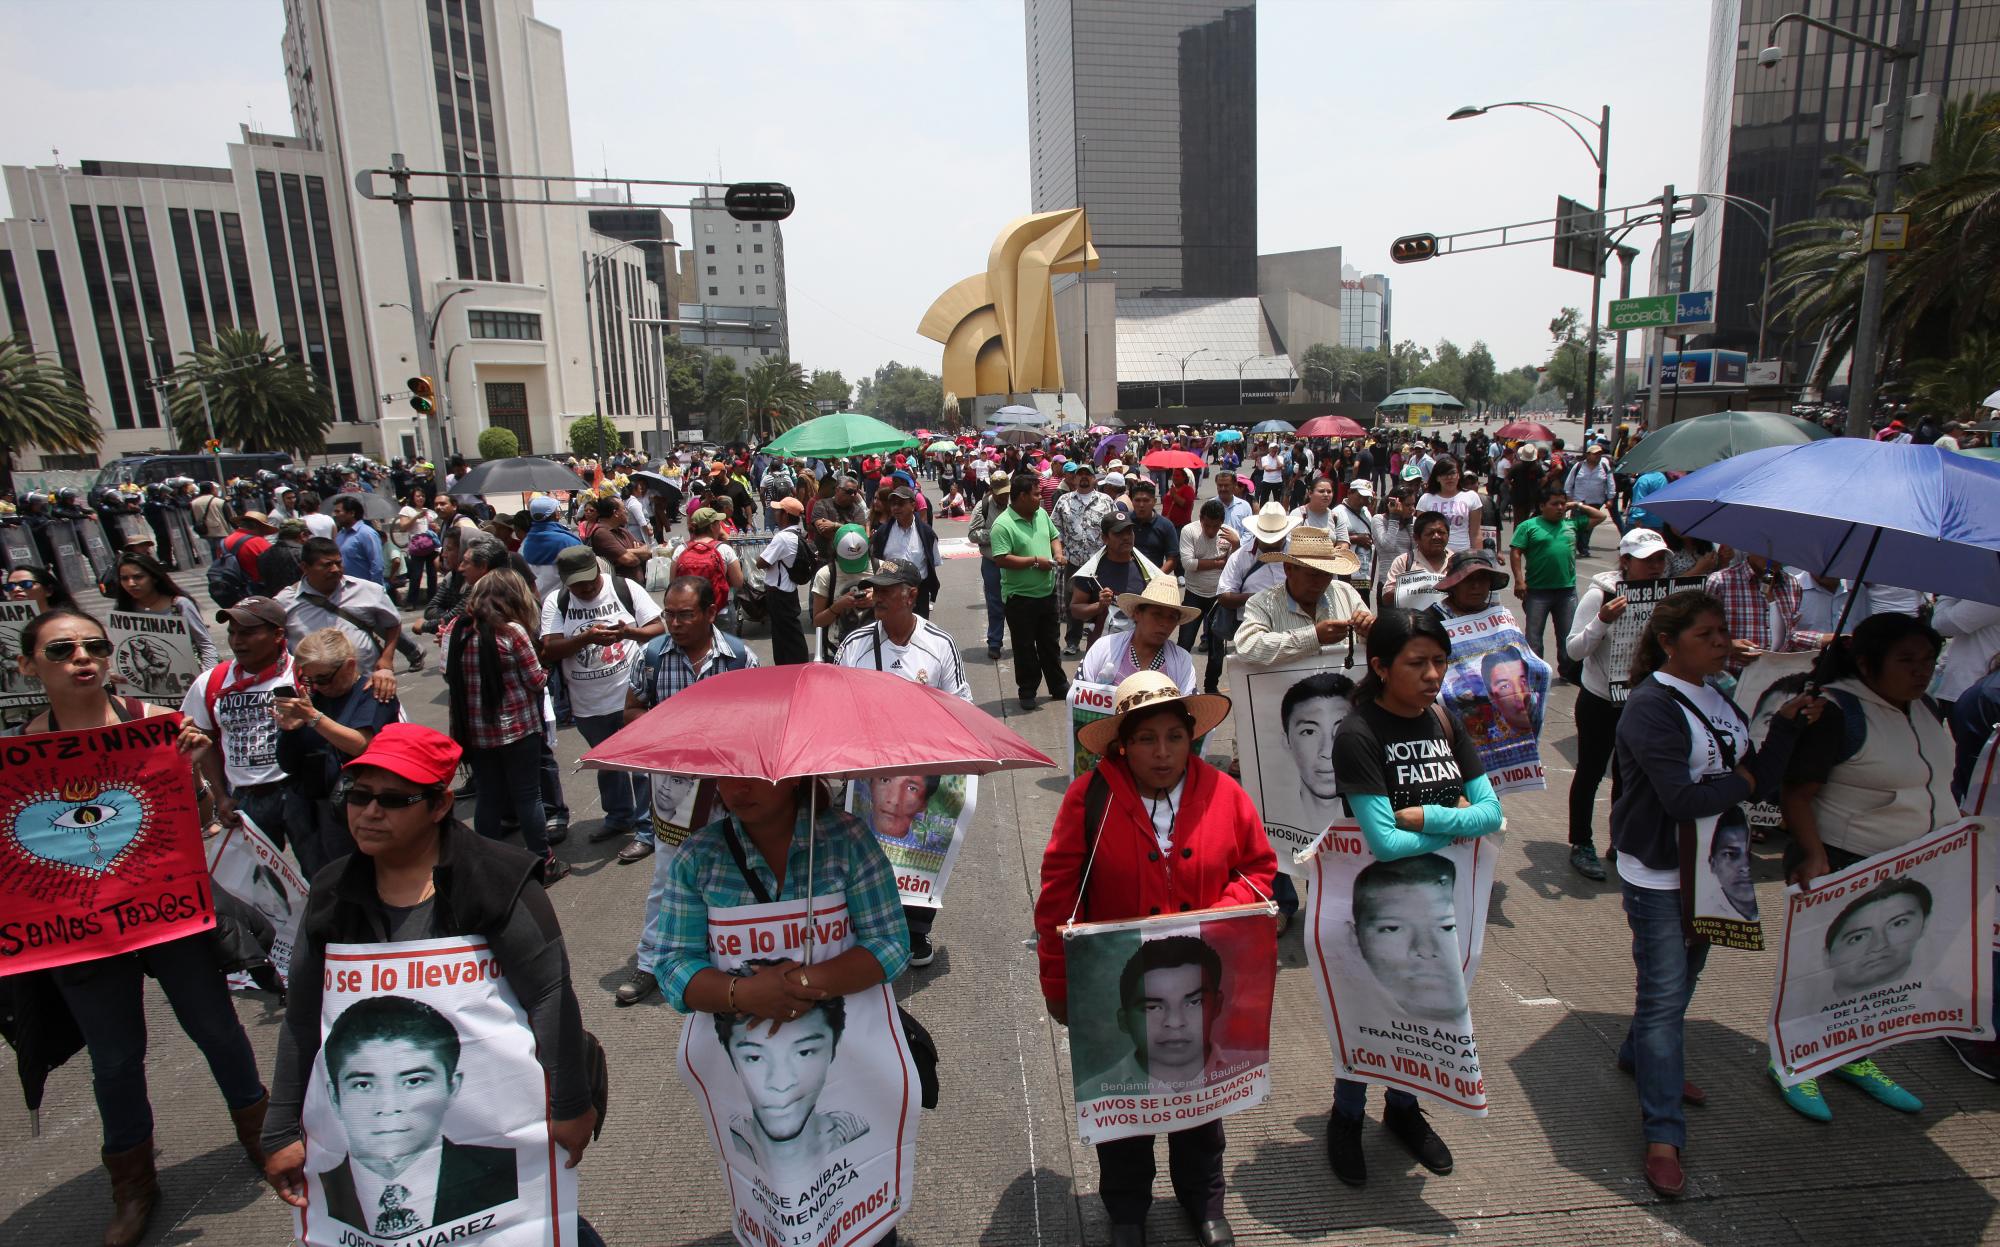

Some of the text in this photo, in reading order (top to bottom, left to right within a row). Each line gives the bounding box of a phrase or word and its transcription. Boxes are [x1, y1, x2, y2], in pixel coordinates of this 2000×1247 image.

[1615, 303, 1640, 311] ZONA
[1642, 586, 1652, 600] se
[1654, 580, 1667, 600] los
[110, 614, 186, 635] AYOTZINAPA
[1457, 624, 1472, 636] se
[1475, 621, 1487, 633] lo
[119, 650, 130, 665] Nos
[1075, 687, 1113, 709] ¡Nos
[1385, 739, 1454, 764] YOTZINA
[1397, 761, 1462, 784] FALTAN
[1503, 765, 1533, 783] VIDA
[256, 845, 268, 860] se
[270, 855, 279, 870] lo
[897, 874, 931, 893] stán
[1796, 832, 1969, 914] ¡Vivo se lo llevaron!
[1692, 920, 1759, 933] Vivos se los
[1696, 927, 1726, 936] Vivos
[1730, 931, 1747, 940] los
[717, 934, 742, 956] se
[748, 928, 775, 954] lo
[1710, 936, 1759, 949] La lucha
[337, 970, 362, 993] se
[372, 964, 398, 992] lo
[407, 957, 504, 990] llevaro
[1820, 981, 1923, 1013] ADAN ABRAJAN
[1833, 994, 1909, 1019] DE LA CRUZ
[1391, 1020, 1429, 1036] LUIS
[1826, 1003, 1916, 1031] EDAD 24 AÑOS
[1359, 1026, 1456, 1055] FRANCISCO
[1790, 1008, 1964, 1063] ¡Con VIDA lo queremos!
[1352, 1048, 1386, 1068] ¡Con
[1390, 1054, 1432, 1082] VIDA
[1435, 1067, 1450, 1088] lo
[1396, 1046, 1481, 1074] EDAD 20 AÑ
[1157, 1077, 1208, 1090] Ascencio
[1211, 1060, 1250, 1081] Bautista
[1093, 1098, 1136, 1113] VIVOS
[1140, 1098, 1159, 1109] SE
[1164, 1094, 1192, 1107] LOS
[1197, 1069, 1266, 1102] LLEVARON,
[1095, 1085, 1254, 1128] VIVOS LOS QUEREMOS!
[752, 1158, 853, 1209] JORGE ANÍBAL
[752, 1170, 859, 1227] CRUZ MENDOZA
[739, 1208, 762, 1243] ¡Con
[764, 1198, 845, 1245] EDAD 19 AÑOS
